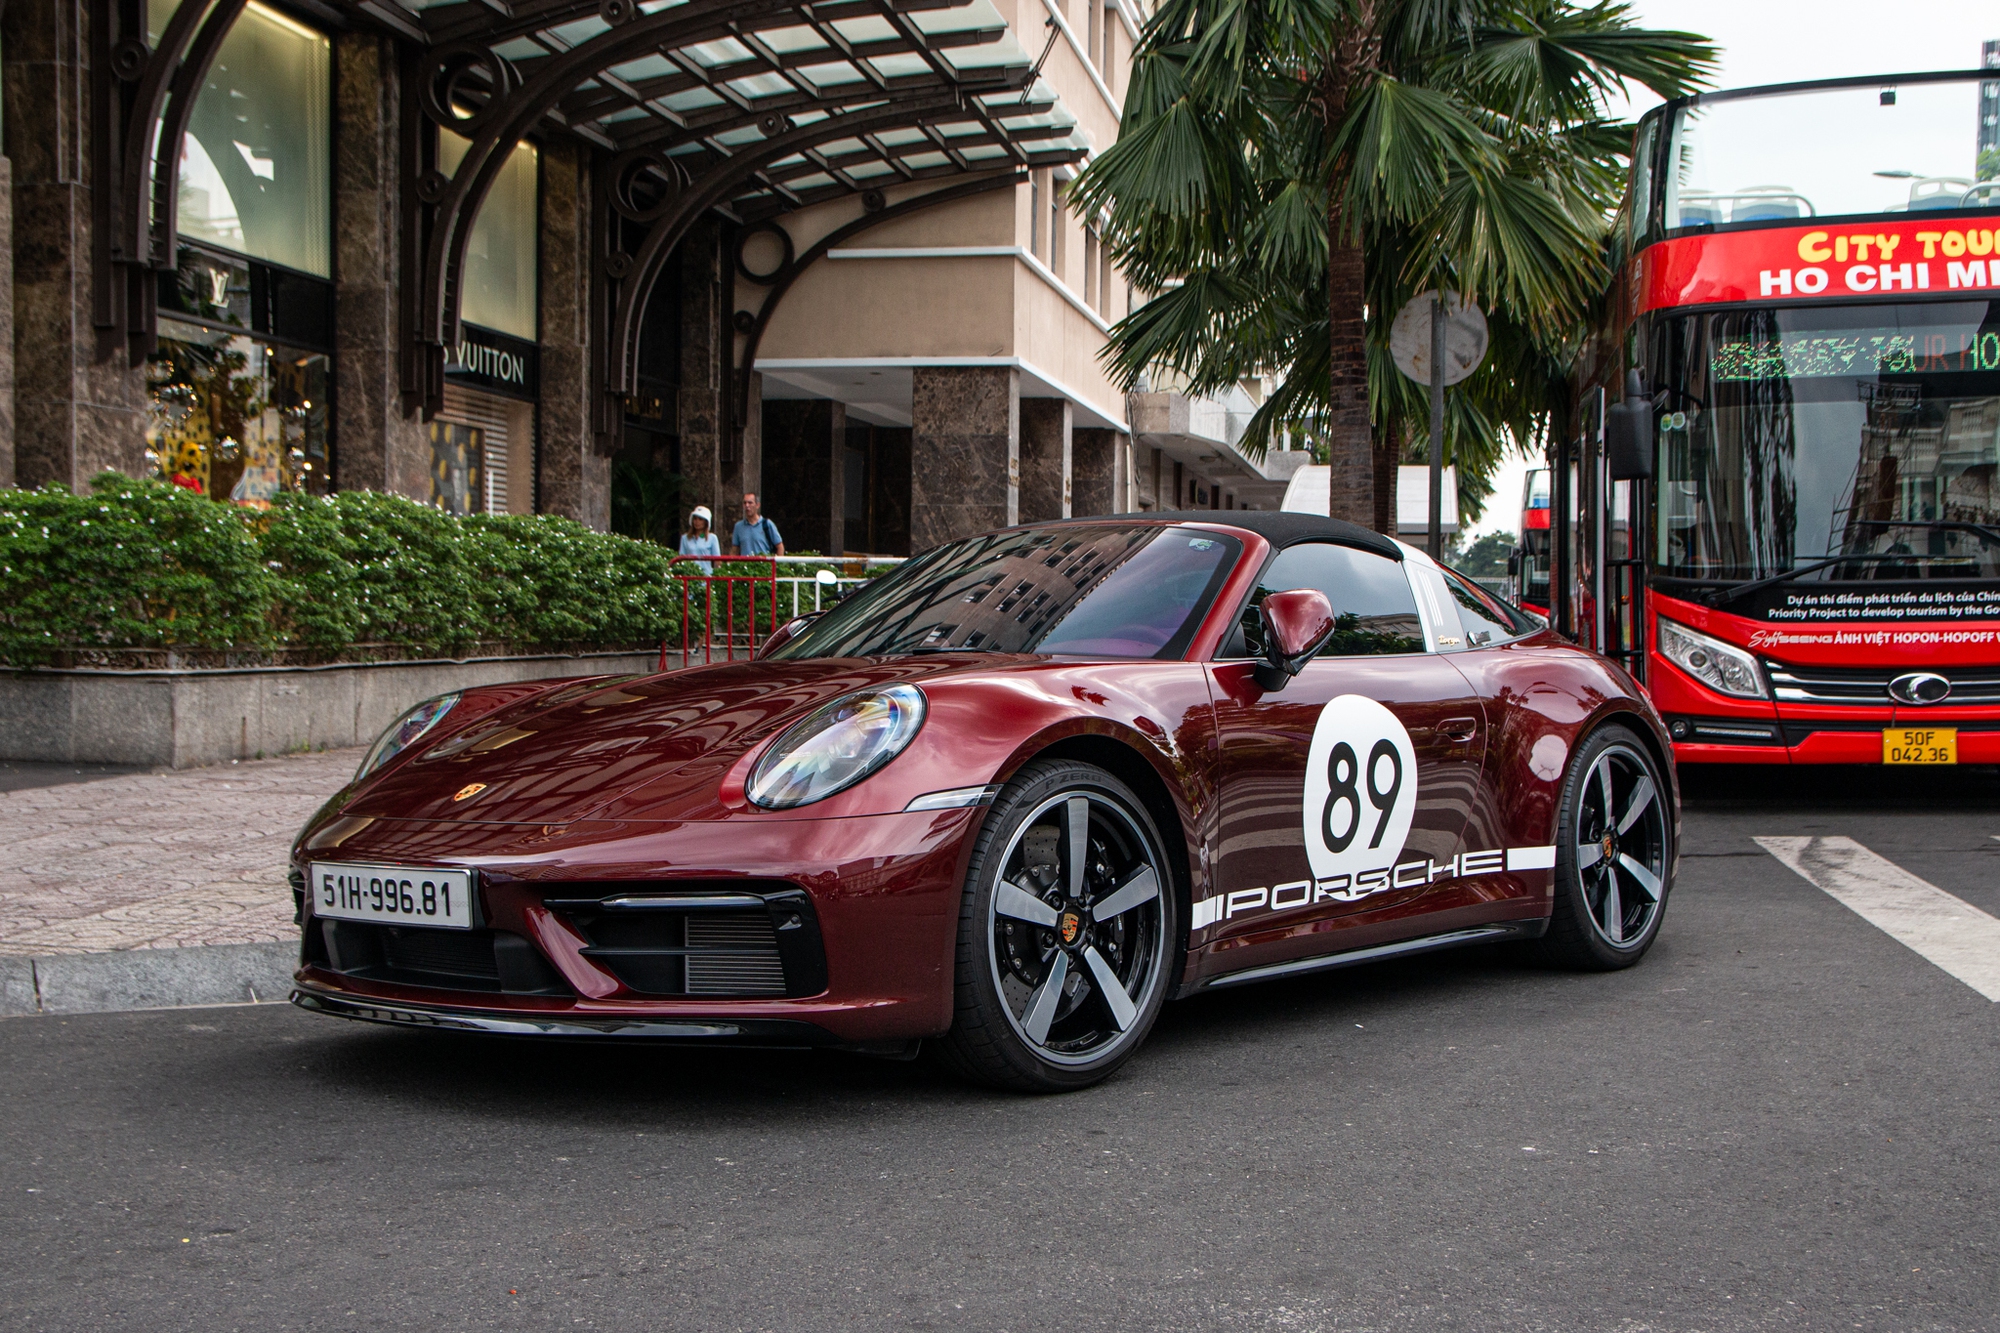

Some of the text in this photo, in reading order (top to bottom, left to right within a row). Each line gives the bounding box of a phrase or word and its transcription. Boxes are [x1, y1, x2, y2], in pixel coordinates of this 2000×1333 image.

[1797, 229, 2000, 264] CITY TOU
[1759, 267, 1829, 297] HO
[1844, 262, 1930, 292] CHI
[456, 340, 524, 386] VUITTON
[1768, 604, 2000, 620] Priority Project to develop tourism by the Go
[1864, 593, 1890, 606] phát
[1863, 631, 1892, 646] VIỆT
[1893, 631, 1995, 644] HOPON-HOPOFF
[1891, 747, 1949, 762] 042.36
[1904, 731, 1935, 746] 50F
[1321, 738, 1403, 854] 89
[322, 873, 451, 917] 51H-996.81
[1226, 849, 1503, 920] PORSCHE
